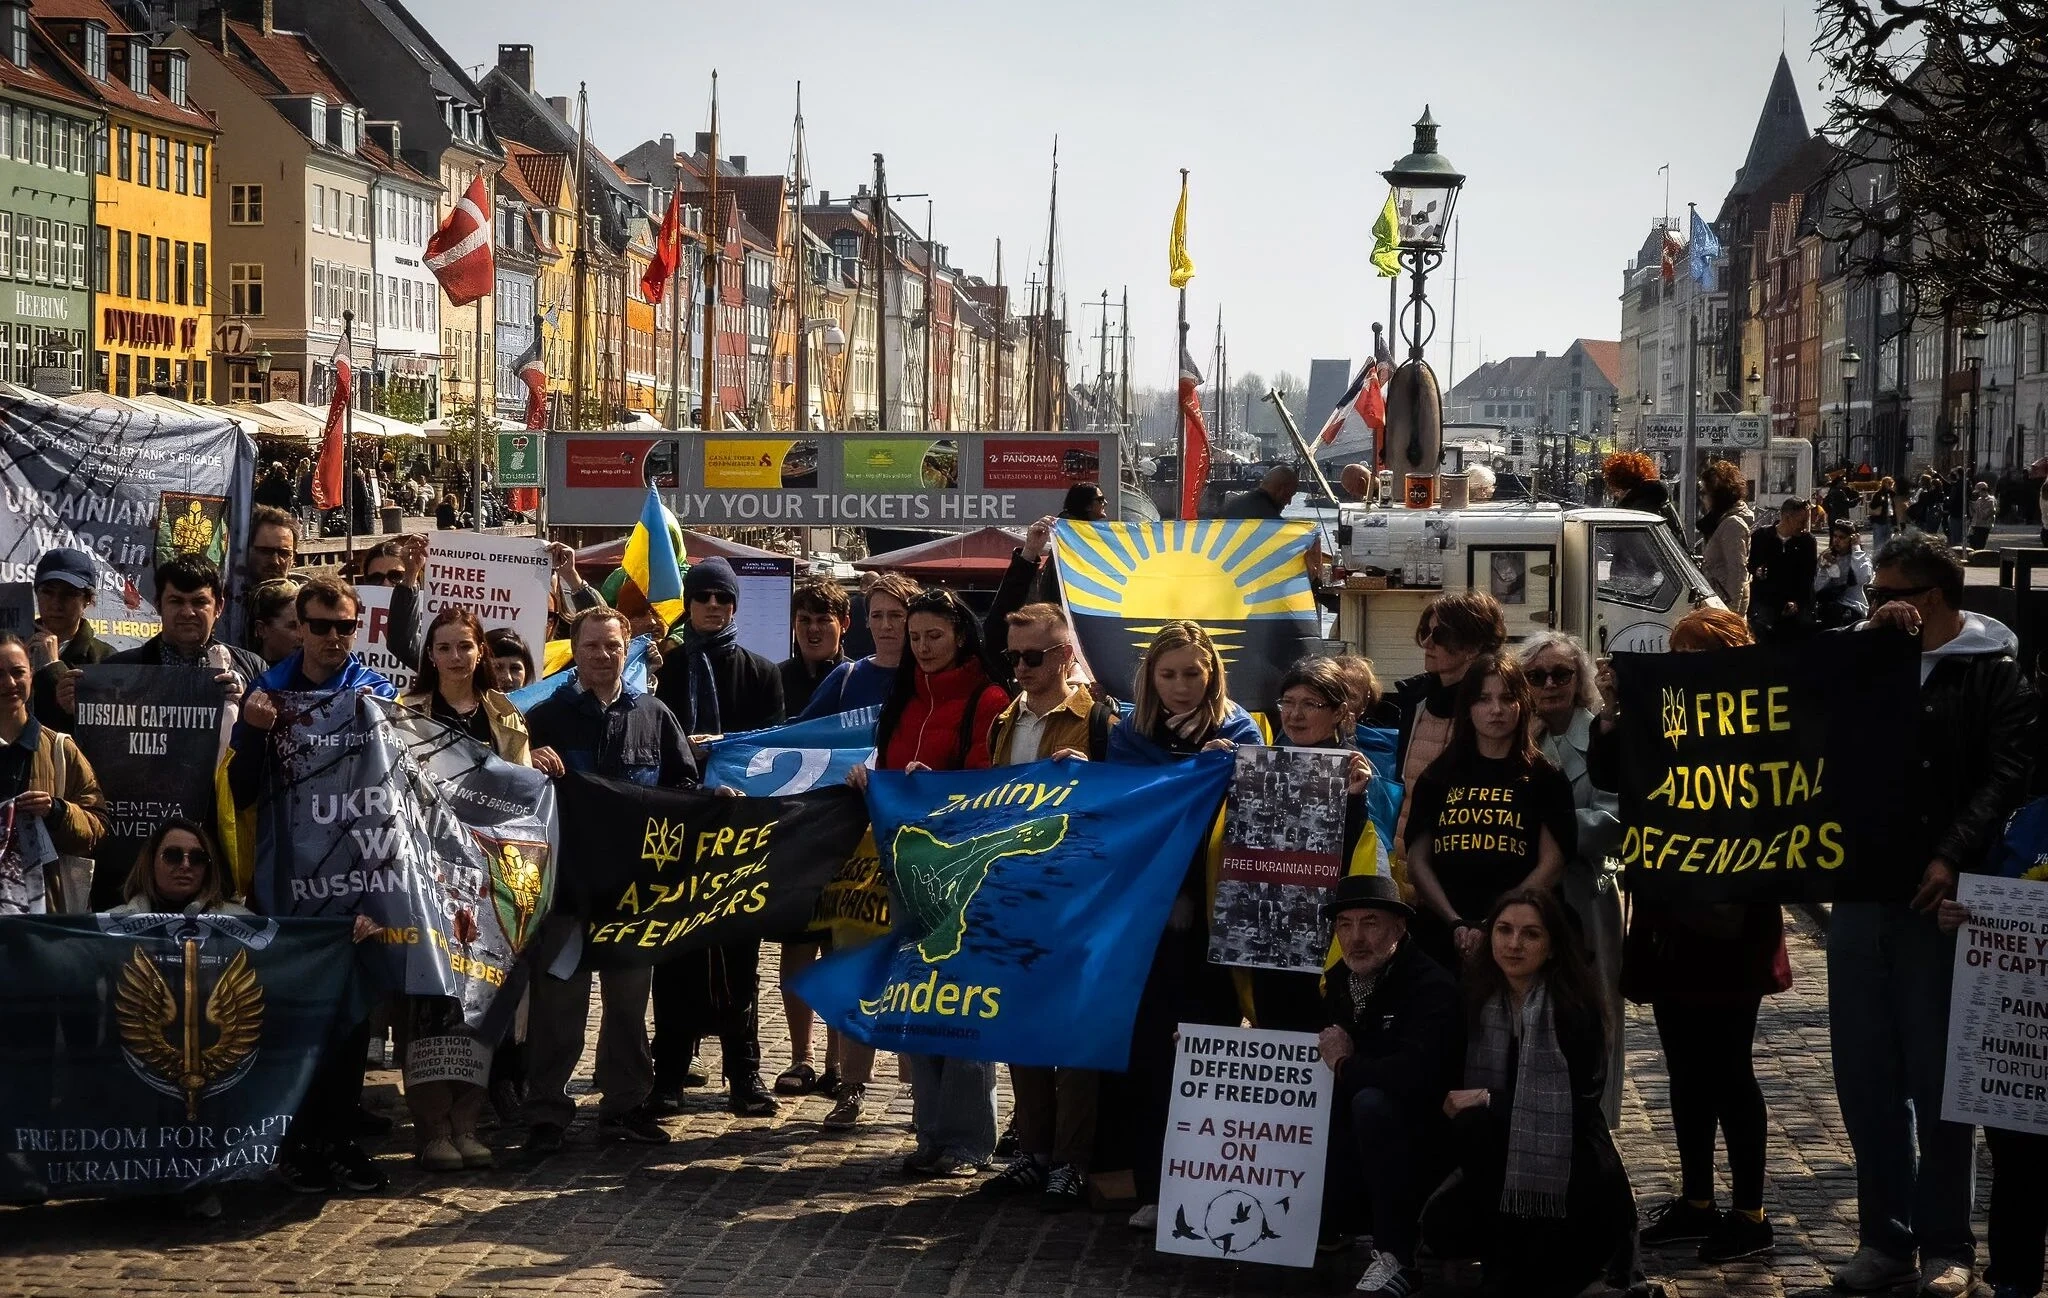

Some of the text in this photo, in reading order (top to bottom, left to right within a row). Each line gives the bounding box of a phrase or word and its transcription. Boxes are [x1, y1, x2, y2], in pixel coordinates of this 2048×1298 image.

[15, 290, 68, 320] HEERING
[104, 308, 176, 348] NYHAVN
[216, 324, 245, 352] 17
[1003, 455, 1058, 463] PANORAMA
[720, 494, 802, 518] YOUR
[812, 494, 930, 518] TICKETS
[941, 494, 1016, 519] HERE
[430, 547, 549, 566] MARIUPOL DEFENDERS
[430, 564, 486, 583] THREE
[429, 582, 511, 603] YEARS IN
[90, 619, 162, 638] HE HEROE
[78, 702, 217, 730] RUSSIAN CAPTIVITY
[1695, 686, 1791, 737] FREE
[129, 732, 168, 755] KILLS
[307, 734, 340, 747] THE
[1468, 788, 1514, 802] FREE
[1647, 757, 1825, 811] AZOVSTAL
[487, 797, 531, 815] BRIGADE
[1438, 808, 1524, 829] AZOVSTAL
[695, 819, 780, 864] FREE
[1434, 834, 1527, 856] DEFENDERS
[1622, 822, 1845, 875] DEFENDERS
[1223, 857, 1339, 877] FREE UKRAINIAN POW
[291, 869, 409, 901] RUSSIAN
[589, 881, 770, 948] EFENDERS
[1968, 914, 2037, 933] MARIUPOL
[384, 926, 420, 944] ING
[1968, 928, 2028, 954] THREE
[1966, 949, 2048, 977] OF CAPT
[445, 1037, 471, 1046] HOW
[447, 1048, 473, 1057] WHO
[1184, 1036, 1321, 1063] IMPRISONED
[1981, 1036, 2048, 1060] HUMILI
[448, 1067, 475, 1078] LOOK
[1190, 1059, 1313, 1085] DEFENDERS
[1180, 1081, 1317, 1108] OF FREEDOM
[1981, 1078, 2048, 1102] UNCER
[15, 1114, 293, 1151] FREEDOM FOR CAPT
[1177, 1118, 1313, 1145] = A SHAME
[1221, 1142, 1257, 1162] ON
[47, 1157, 202, 1183] UKRAINIAN
[1168, 1159, 1305, 1189] HUMANITY
